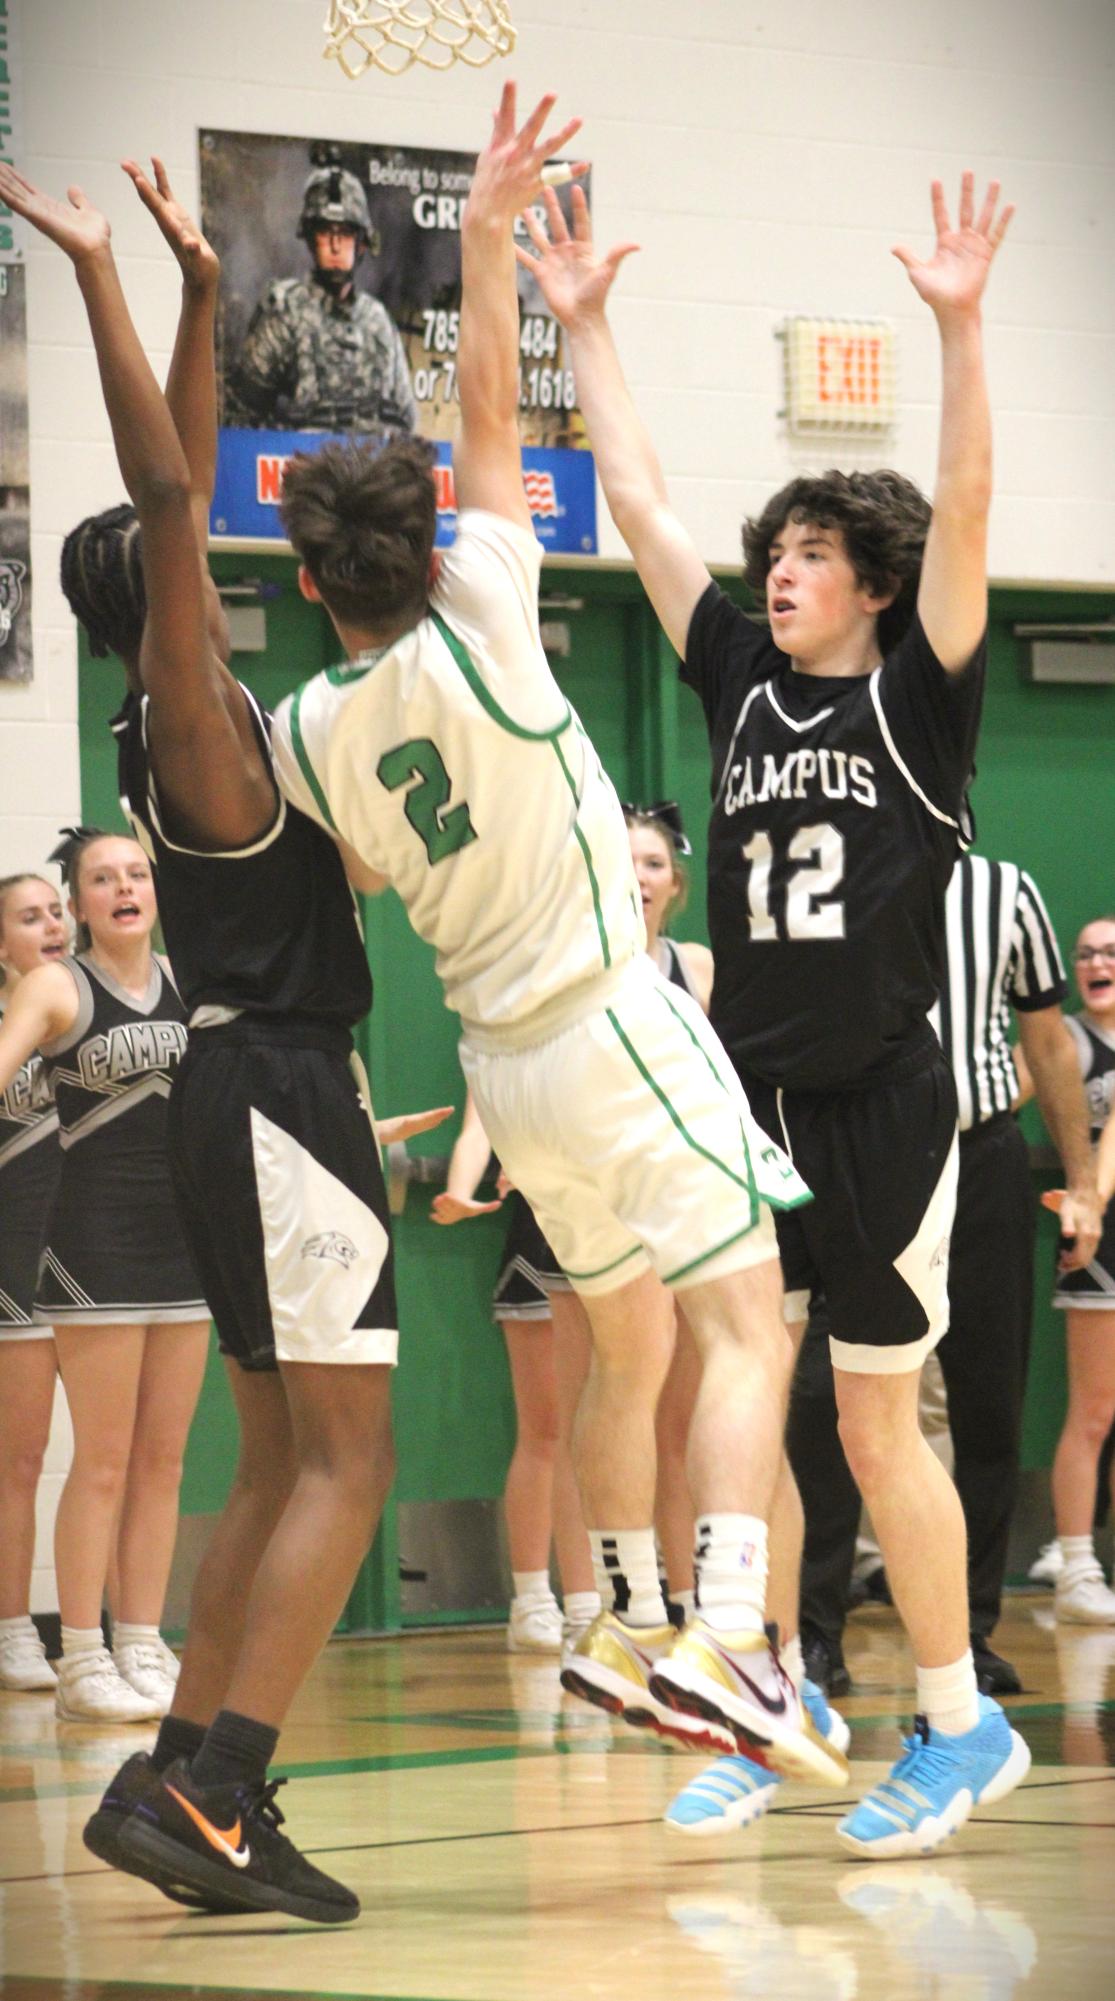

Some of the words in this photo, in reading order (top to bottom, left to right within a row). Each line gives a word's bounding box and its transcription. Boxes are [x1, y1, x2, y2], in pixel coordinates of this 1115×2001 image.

[369, 160, 421, 195] Belong
[422, 168, 439, 190] to
[414, 369, 437, 401] or
[817, 335, 880, 404] EXIT
[376, 736, 479, 867] 2
[724, 748, 878, 817] CAMPUS
[741, 822, 846, 941] 12
